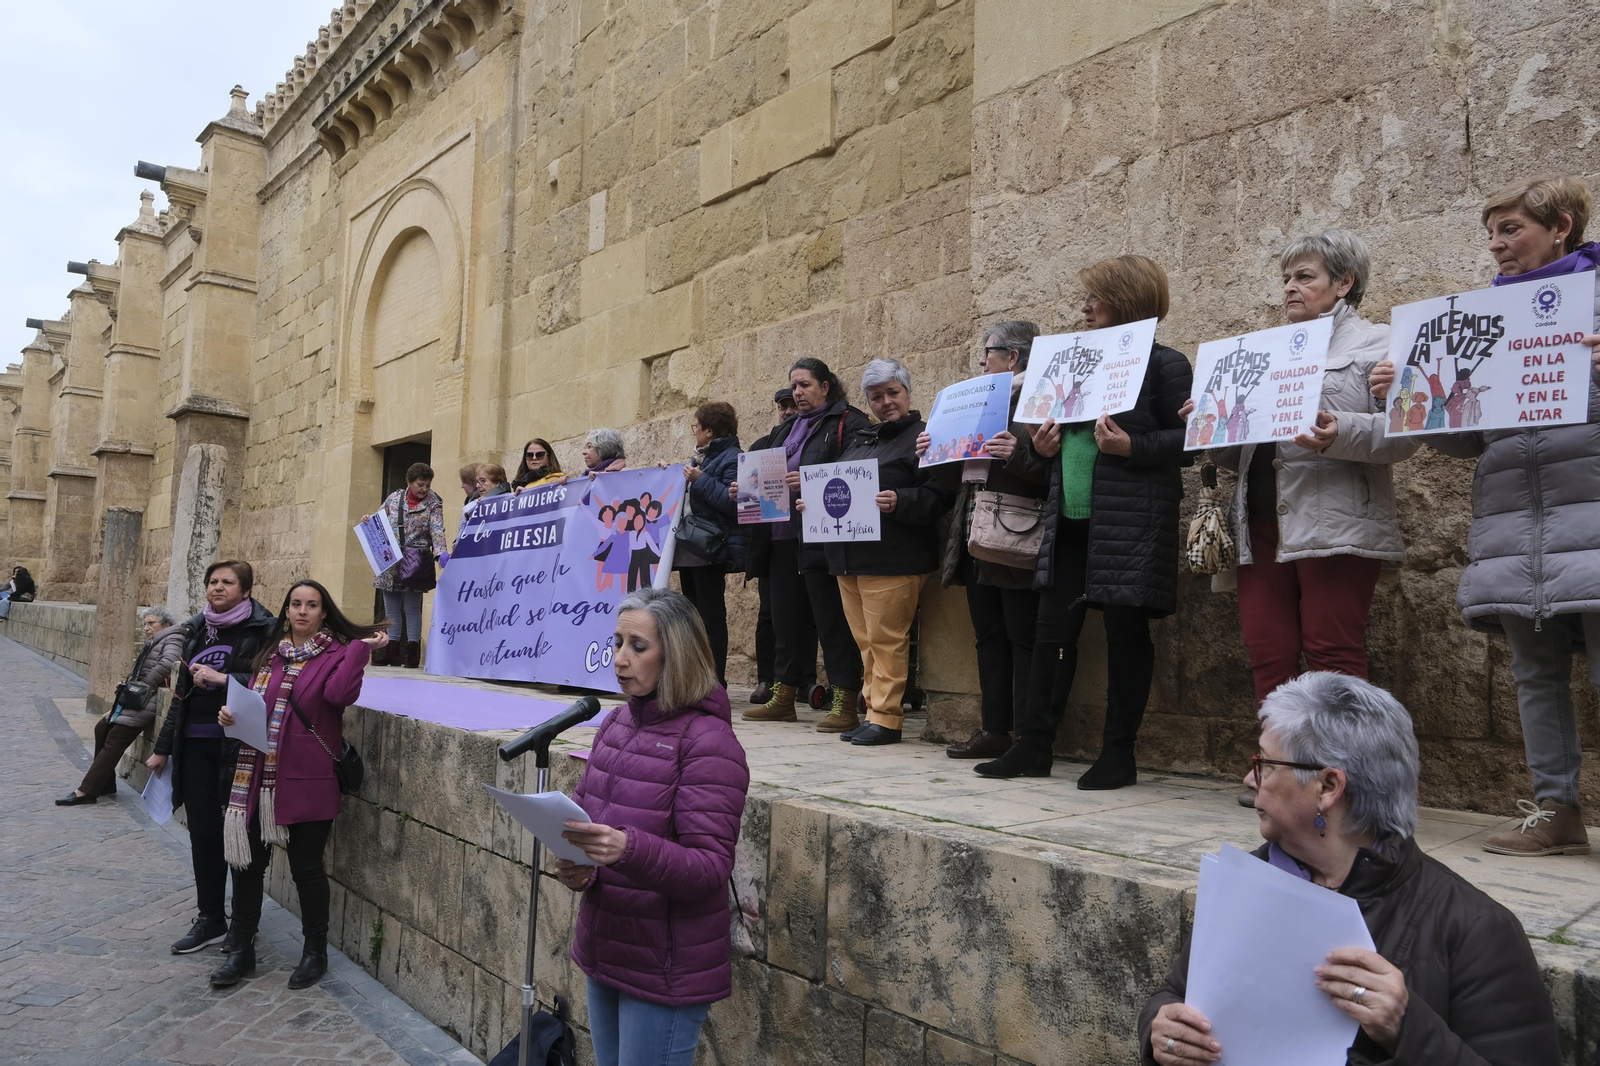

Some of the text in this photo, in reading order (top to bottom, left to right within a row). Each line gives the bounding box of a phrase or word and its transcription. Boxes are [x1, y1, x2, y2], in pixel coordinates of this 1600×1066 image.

[1415, 310, 1505, 343] ALCEMOS
[1508, 331, 1584, 351] IGUALDAD
[1050, 346, 1104, 365] ALCEMOS
[1406, 335, 1498, 366] LA VOZ
[1103, 357, 1140, 371] IGUALDAD
[1212, 349, 1271, 374] ALCEMOS
[1523, 352, 1565, 367] EN LA
[1042, 361, 1099, 378] LA VOZ
[1109, 370, 1130, 380] EN LA
[1270, 365, 1318, 381] IGUALDAD
[1106, 380, 1128, 390] CALLE
[1204, 369, 1265, 393] LA VOZ
[1521, 371, 1564, 385] CALLE
[946, 383, 996, 400] REIVINDICAMOS
[1278, 382, 1304, 394] EN LA
[1108, 392, 1117, 400] EN
[1276, 396, 1303, 408] CALLE
[1516, 389, 1568, 404] Y EN EL
[942, 401, 988, 414] IGUALDAD PLENA
[1101, 402, 1122, 412] ALTAR
[1518, 407, 1562, 422] ALTAR
[1271, 411, 1303, 423] Y EN EL
[1271, 426, 1299, 437] ALTAR
[833, 465, 841, 475] de
[501, 499, 515, 513] DE
[518, 488, 568, 510] MUJERES
[474, 520, 493, 542] la
[821, 517, 830, 534] la
[500, 525, 556, 550] IGLESIA
[458, 573, 505, 602] Hasta
[511, 570, 547, 594] que
[441, 603, 520, 645] igualdad
[526, 607, 546, 626] se
